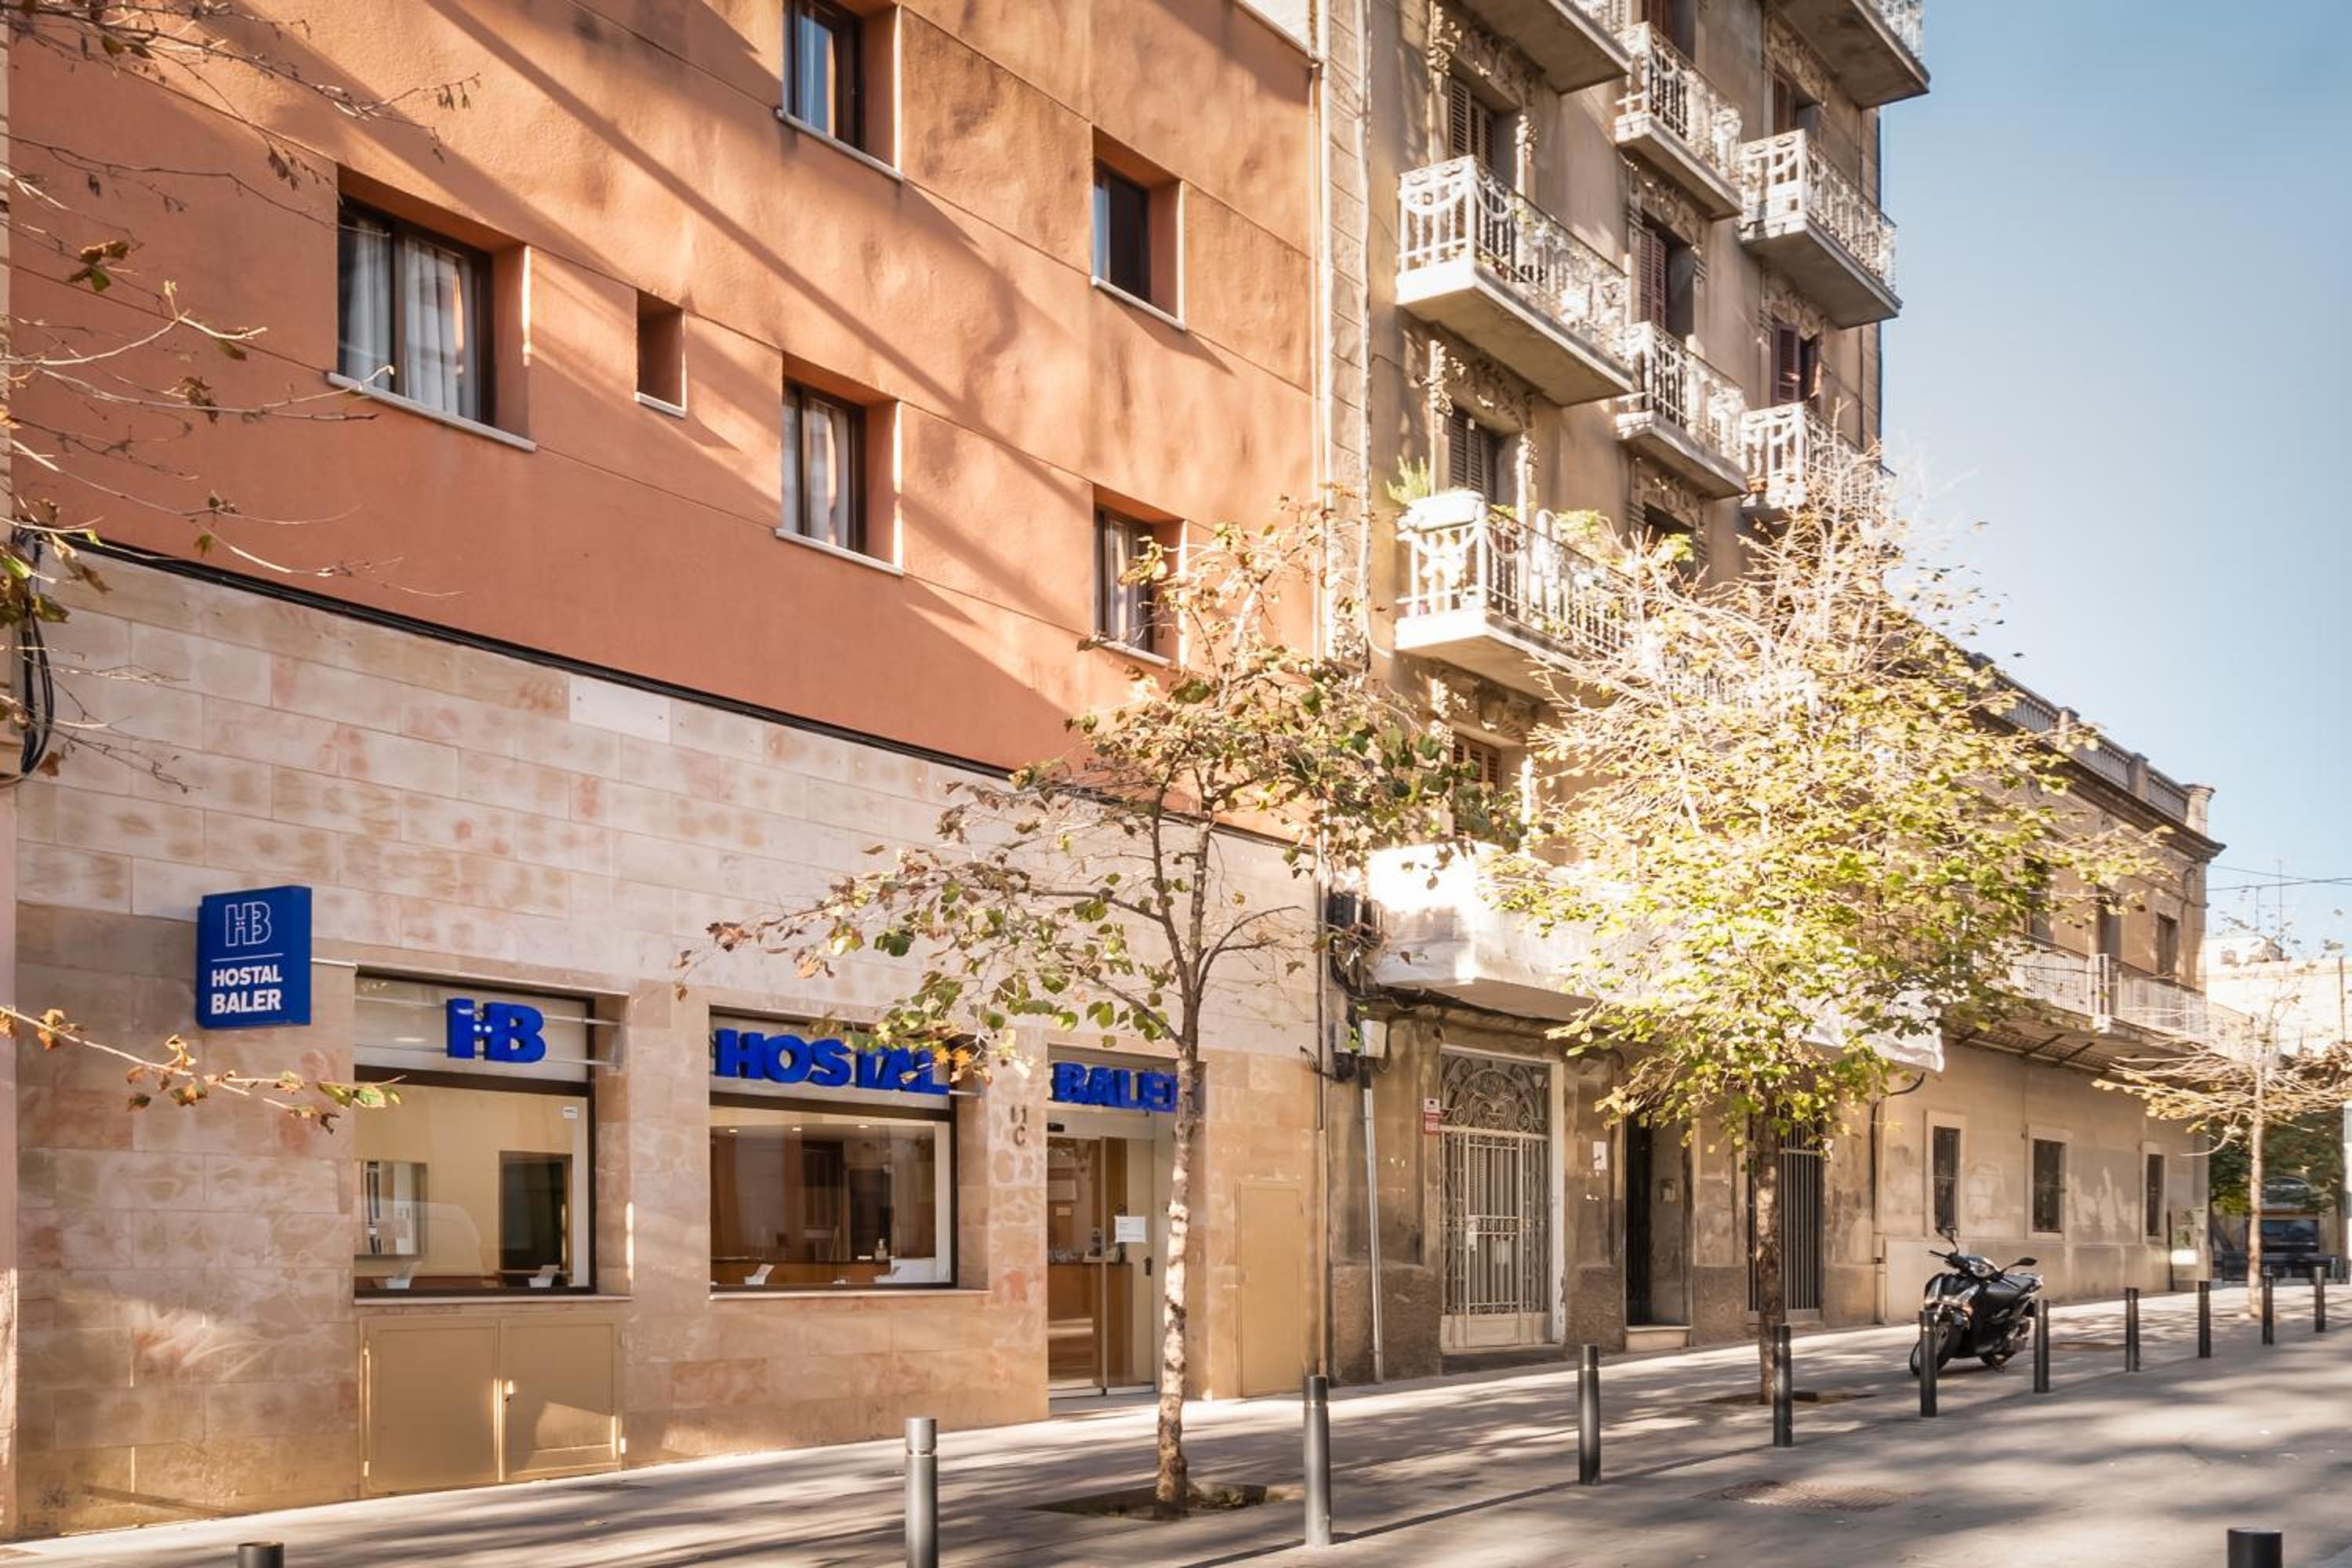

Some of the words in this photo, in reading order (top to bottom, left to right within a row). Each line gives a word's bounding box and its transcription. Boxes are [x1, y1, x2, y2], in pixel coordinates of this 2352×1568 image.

[225, 901, 272, 947] HB
[212, 964, 283, 987] HOSTAL
[211, 989, 281, 1014] BALER
[447, 997, 546, 1063] HB
